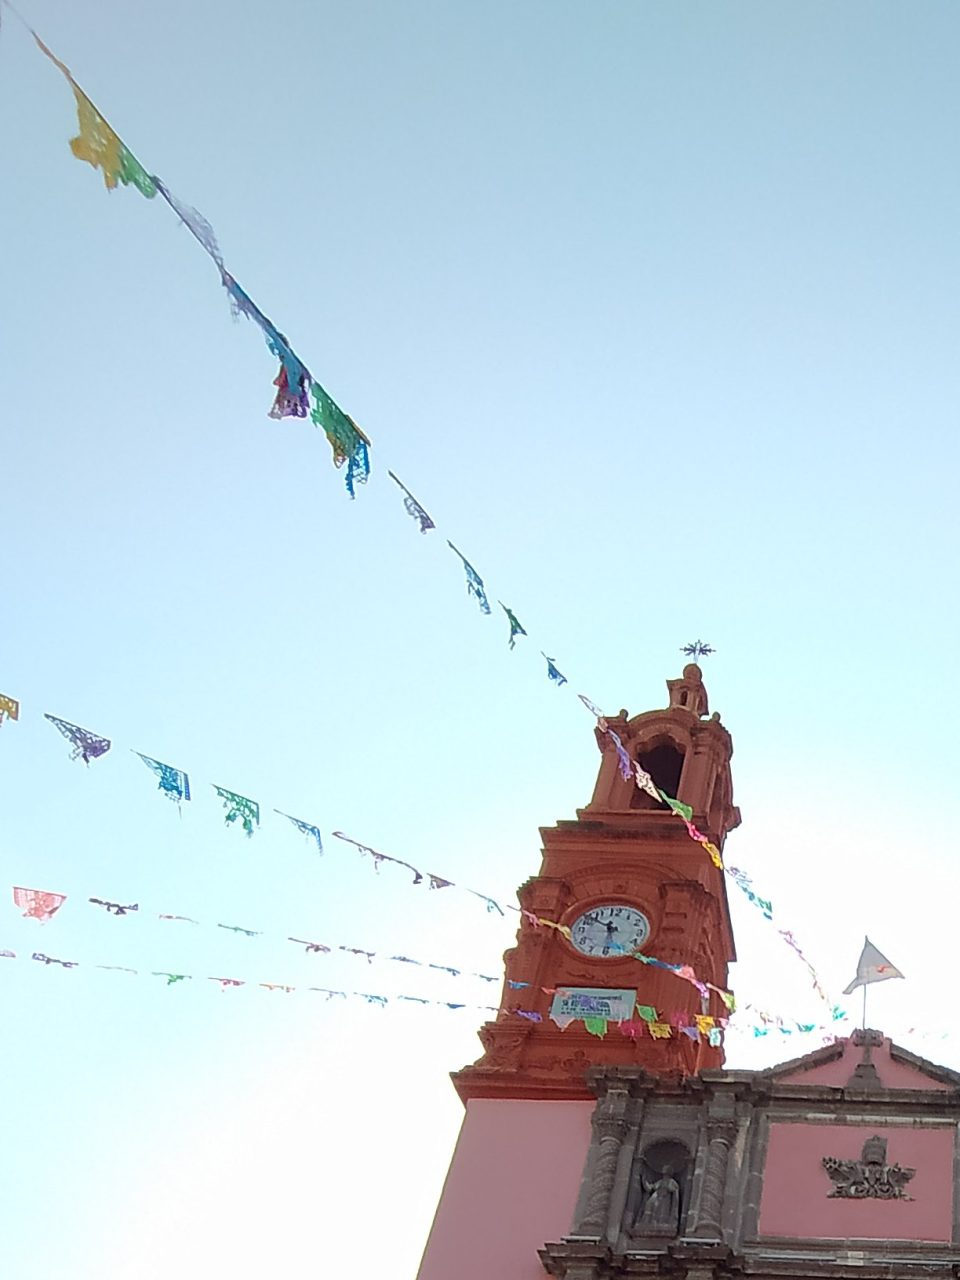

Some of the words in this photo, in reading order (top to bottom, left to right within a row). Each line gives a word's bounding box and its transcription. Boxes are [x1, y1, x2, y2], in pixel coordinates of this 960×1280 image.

[610, 907, 622, 917] 12
[633, 918, 641, 927] 2
[636, 928, 643, 937] 3
[579, 936, 587, 945] 8
[629, 938, 637, 947] 4
[602, 946, 610, 955] 6
